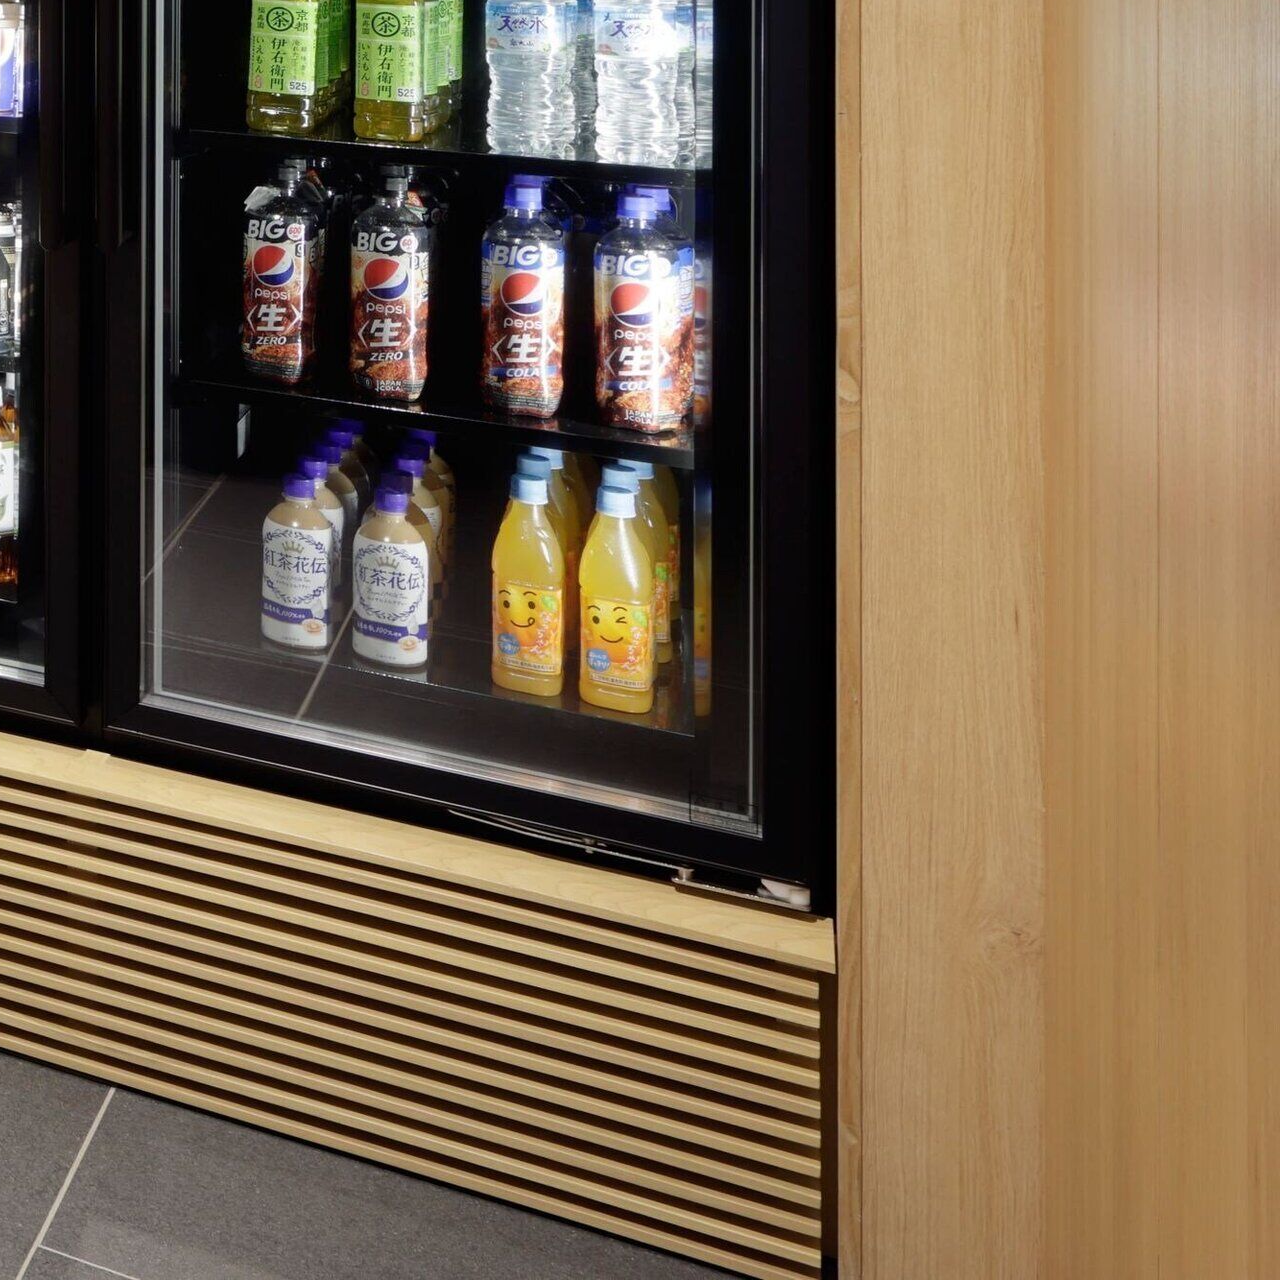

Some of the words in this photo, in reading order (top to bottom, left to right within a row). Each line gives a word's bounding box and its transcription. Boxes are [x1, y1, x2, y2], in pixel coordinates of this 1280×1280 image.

[270, 9, 291, 30] 茶
[293, 9, 310, 33] 京都
[377, 15, 397, 35] 茶
[400, 14, 416, 39] 京都
[497, 15, 548, 33] 天然水
[269, 37, 288, 91] 伊右衛門
[376, 43, 394, 98] 伊右衛門
[289, 81, 308, 91] 525
[397, 88, 416, 98] 525
[247, 219, 286, 240] BIG
[356, 231, 399, 252] BIG
[493, 244, 536, 267] BIG
[254, 287, 290, 302] pepsi
[366, 301, 407, 316] pepsi
[255, 335, 288, 346] ZERO
[614, 329, 655, 342] peps
[369, 350, 404, 362] ZERO
[505, 367, 541, 378] COLA
[263, 555, 328, 575] 紅茶花伝
[357, 565, 421, 589] 紅茶花伝
